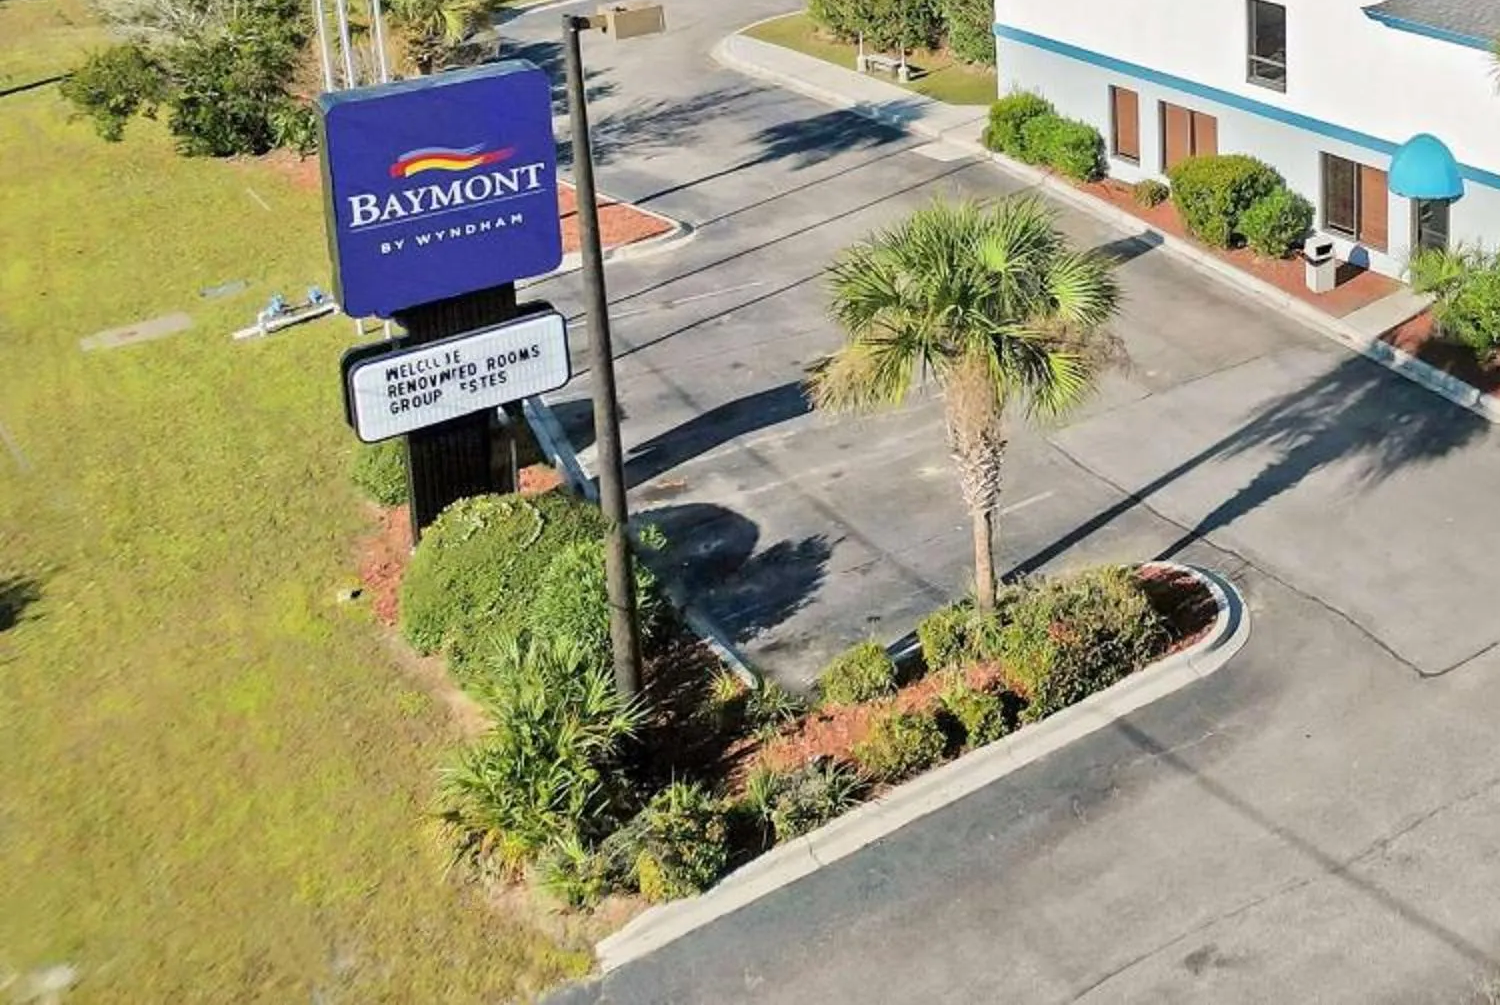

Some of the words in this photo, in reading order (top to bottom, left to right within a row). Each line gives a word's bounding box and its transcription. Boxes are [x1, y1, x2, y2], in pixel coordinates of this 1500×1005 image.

[347, 162, 545, 228] BAYMONT
[380, 240, 405, 254] BY
[415, 212, 524, 246] WYNDHAM
[486, 344, 541, 372] ROOMS
[389, 389, 443, 415] GROUP
